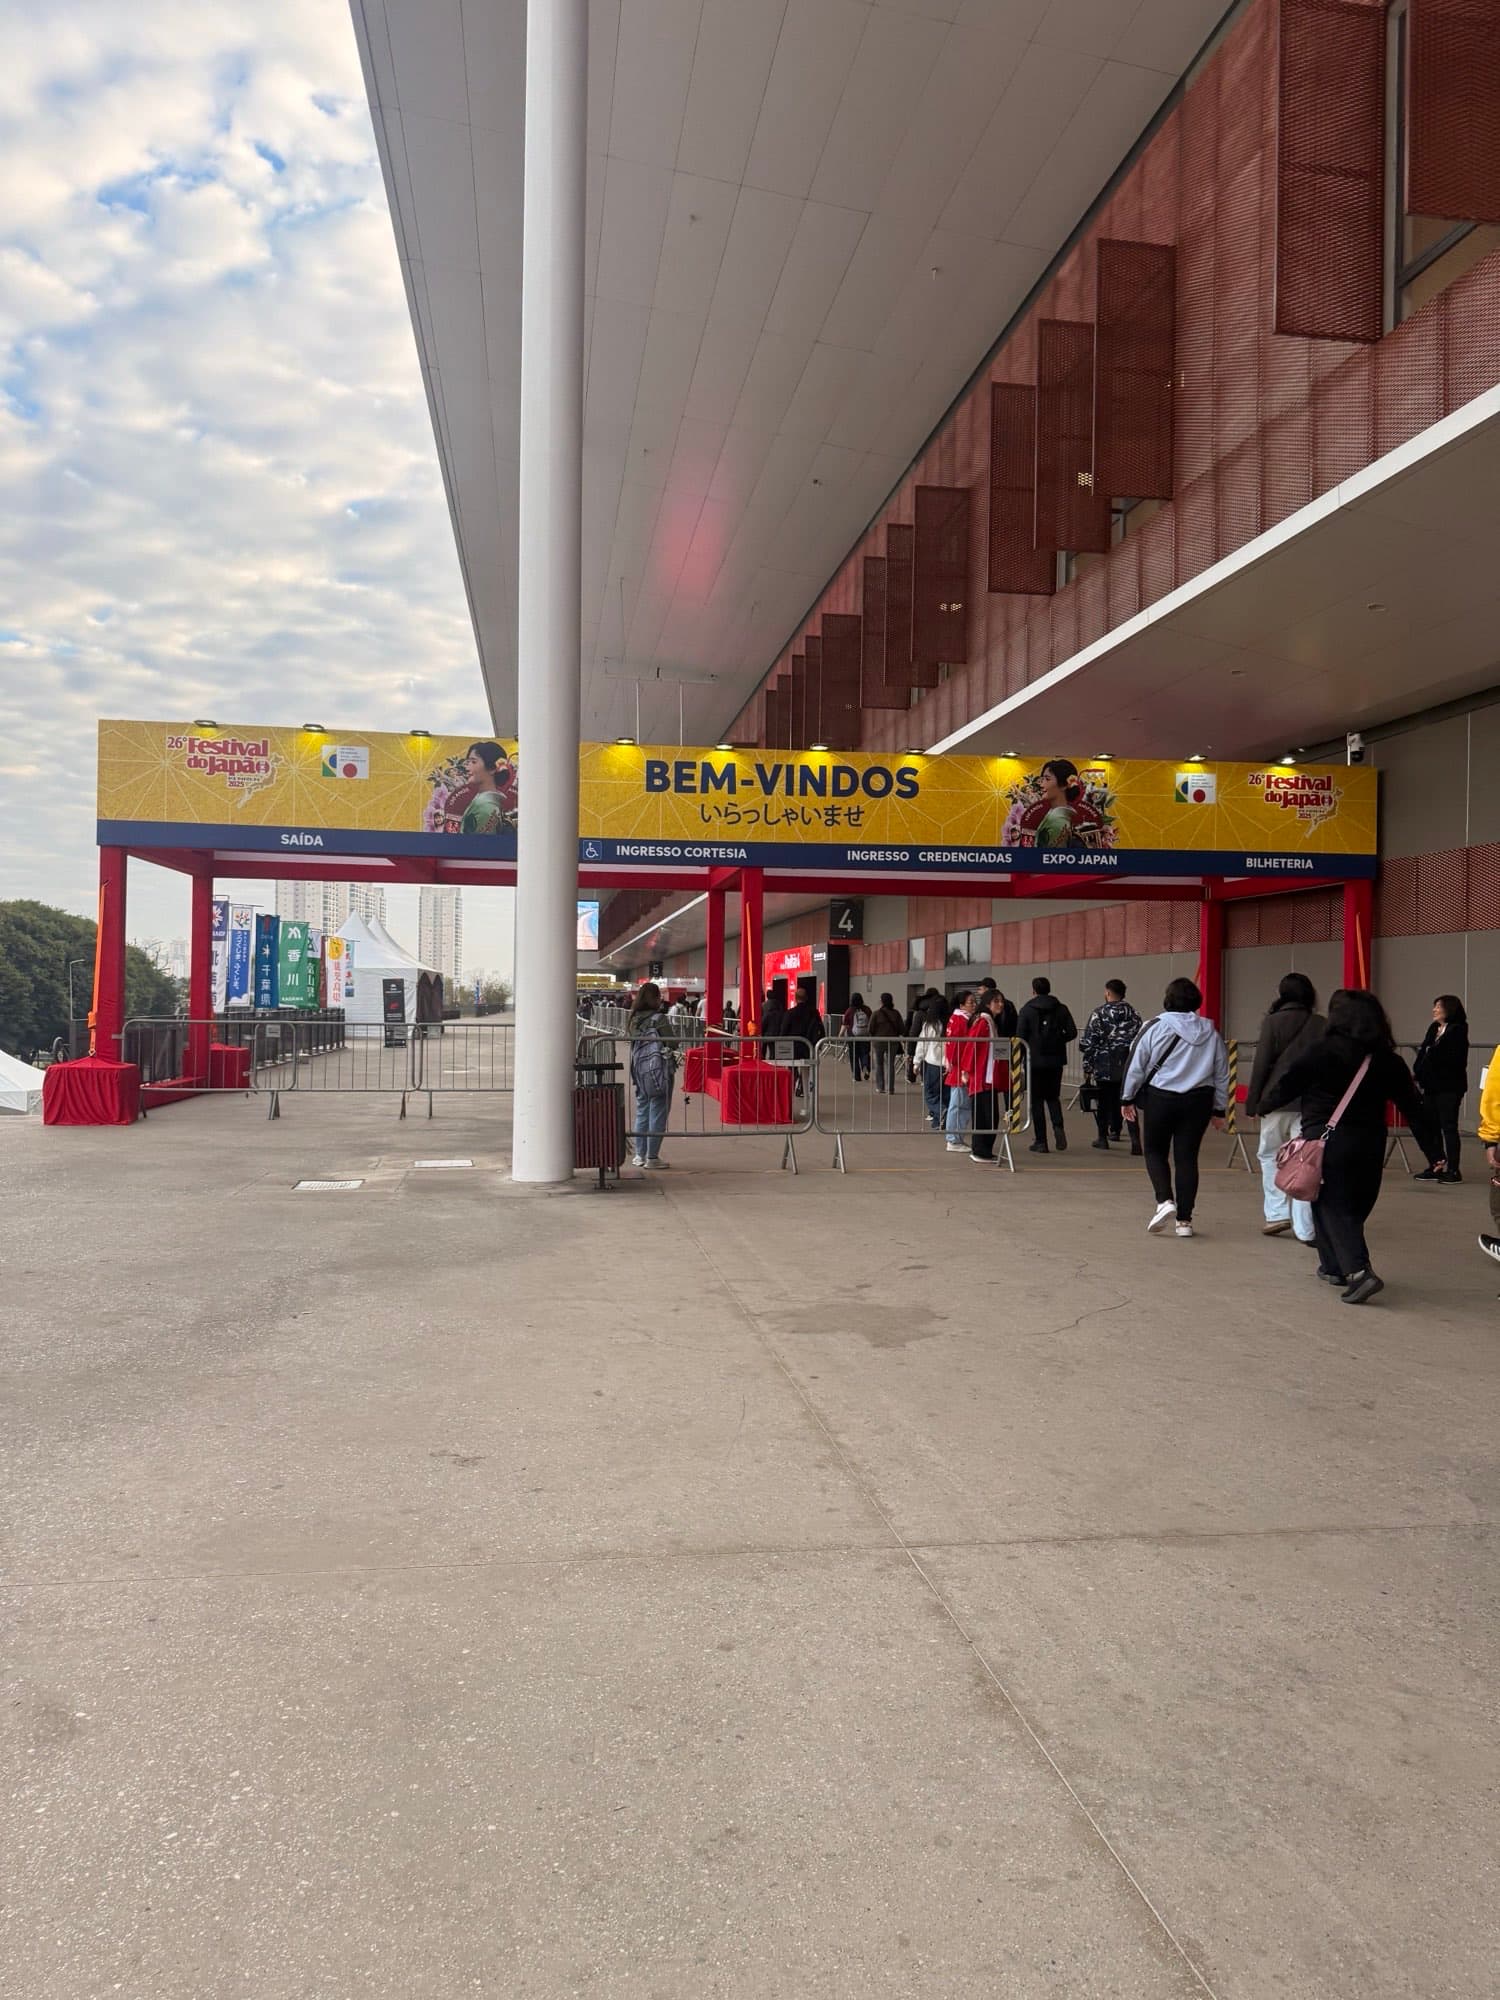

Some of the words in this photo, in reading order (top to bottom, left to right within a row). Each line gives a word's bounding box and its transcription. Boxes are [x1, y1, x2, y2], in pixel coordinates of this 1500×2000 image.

[187, 737, 268, 757] Festival
[187, 755, 208, 769] do
[206, 756, 270, 776] Japão
[645, 759, 920, 799] BEM-VINDOS
[1265, 774, 1332, 791] Festival
[1264, 790, 1282, 803] do
[1280, 791, 1333, 809] Japão
[699, 802, 865, 827] いらっしゃいませ
[280, 832, 324, 847] SAÍDA
[616, 845, 682, 858] INGRESSO
[684, 847, 747, 859] CORTESIA
[847, 850, 910, 862] INGRESSO
[918, 852, 1012, 865] CREDENCIADAS
[1042, 854, 1076, 865] EXPO
[1077, 854, 1118, 866] JAPAN
[1245, 858, 1314, 870] BILHETERIA
[838, 908, 854, 932] 4
[287, 949, 302, 986] 香川
[653, 964, 659, 974] 5
[260, 965, 271, 1006] 千葉県
